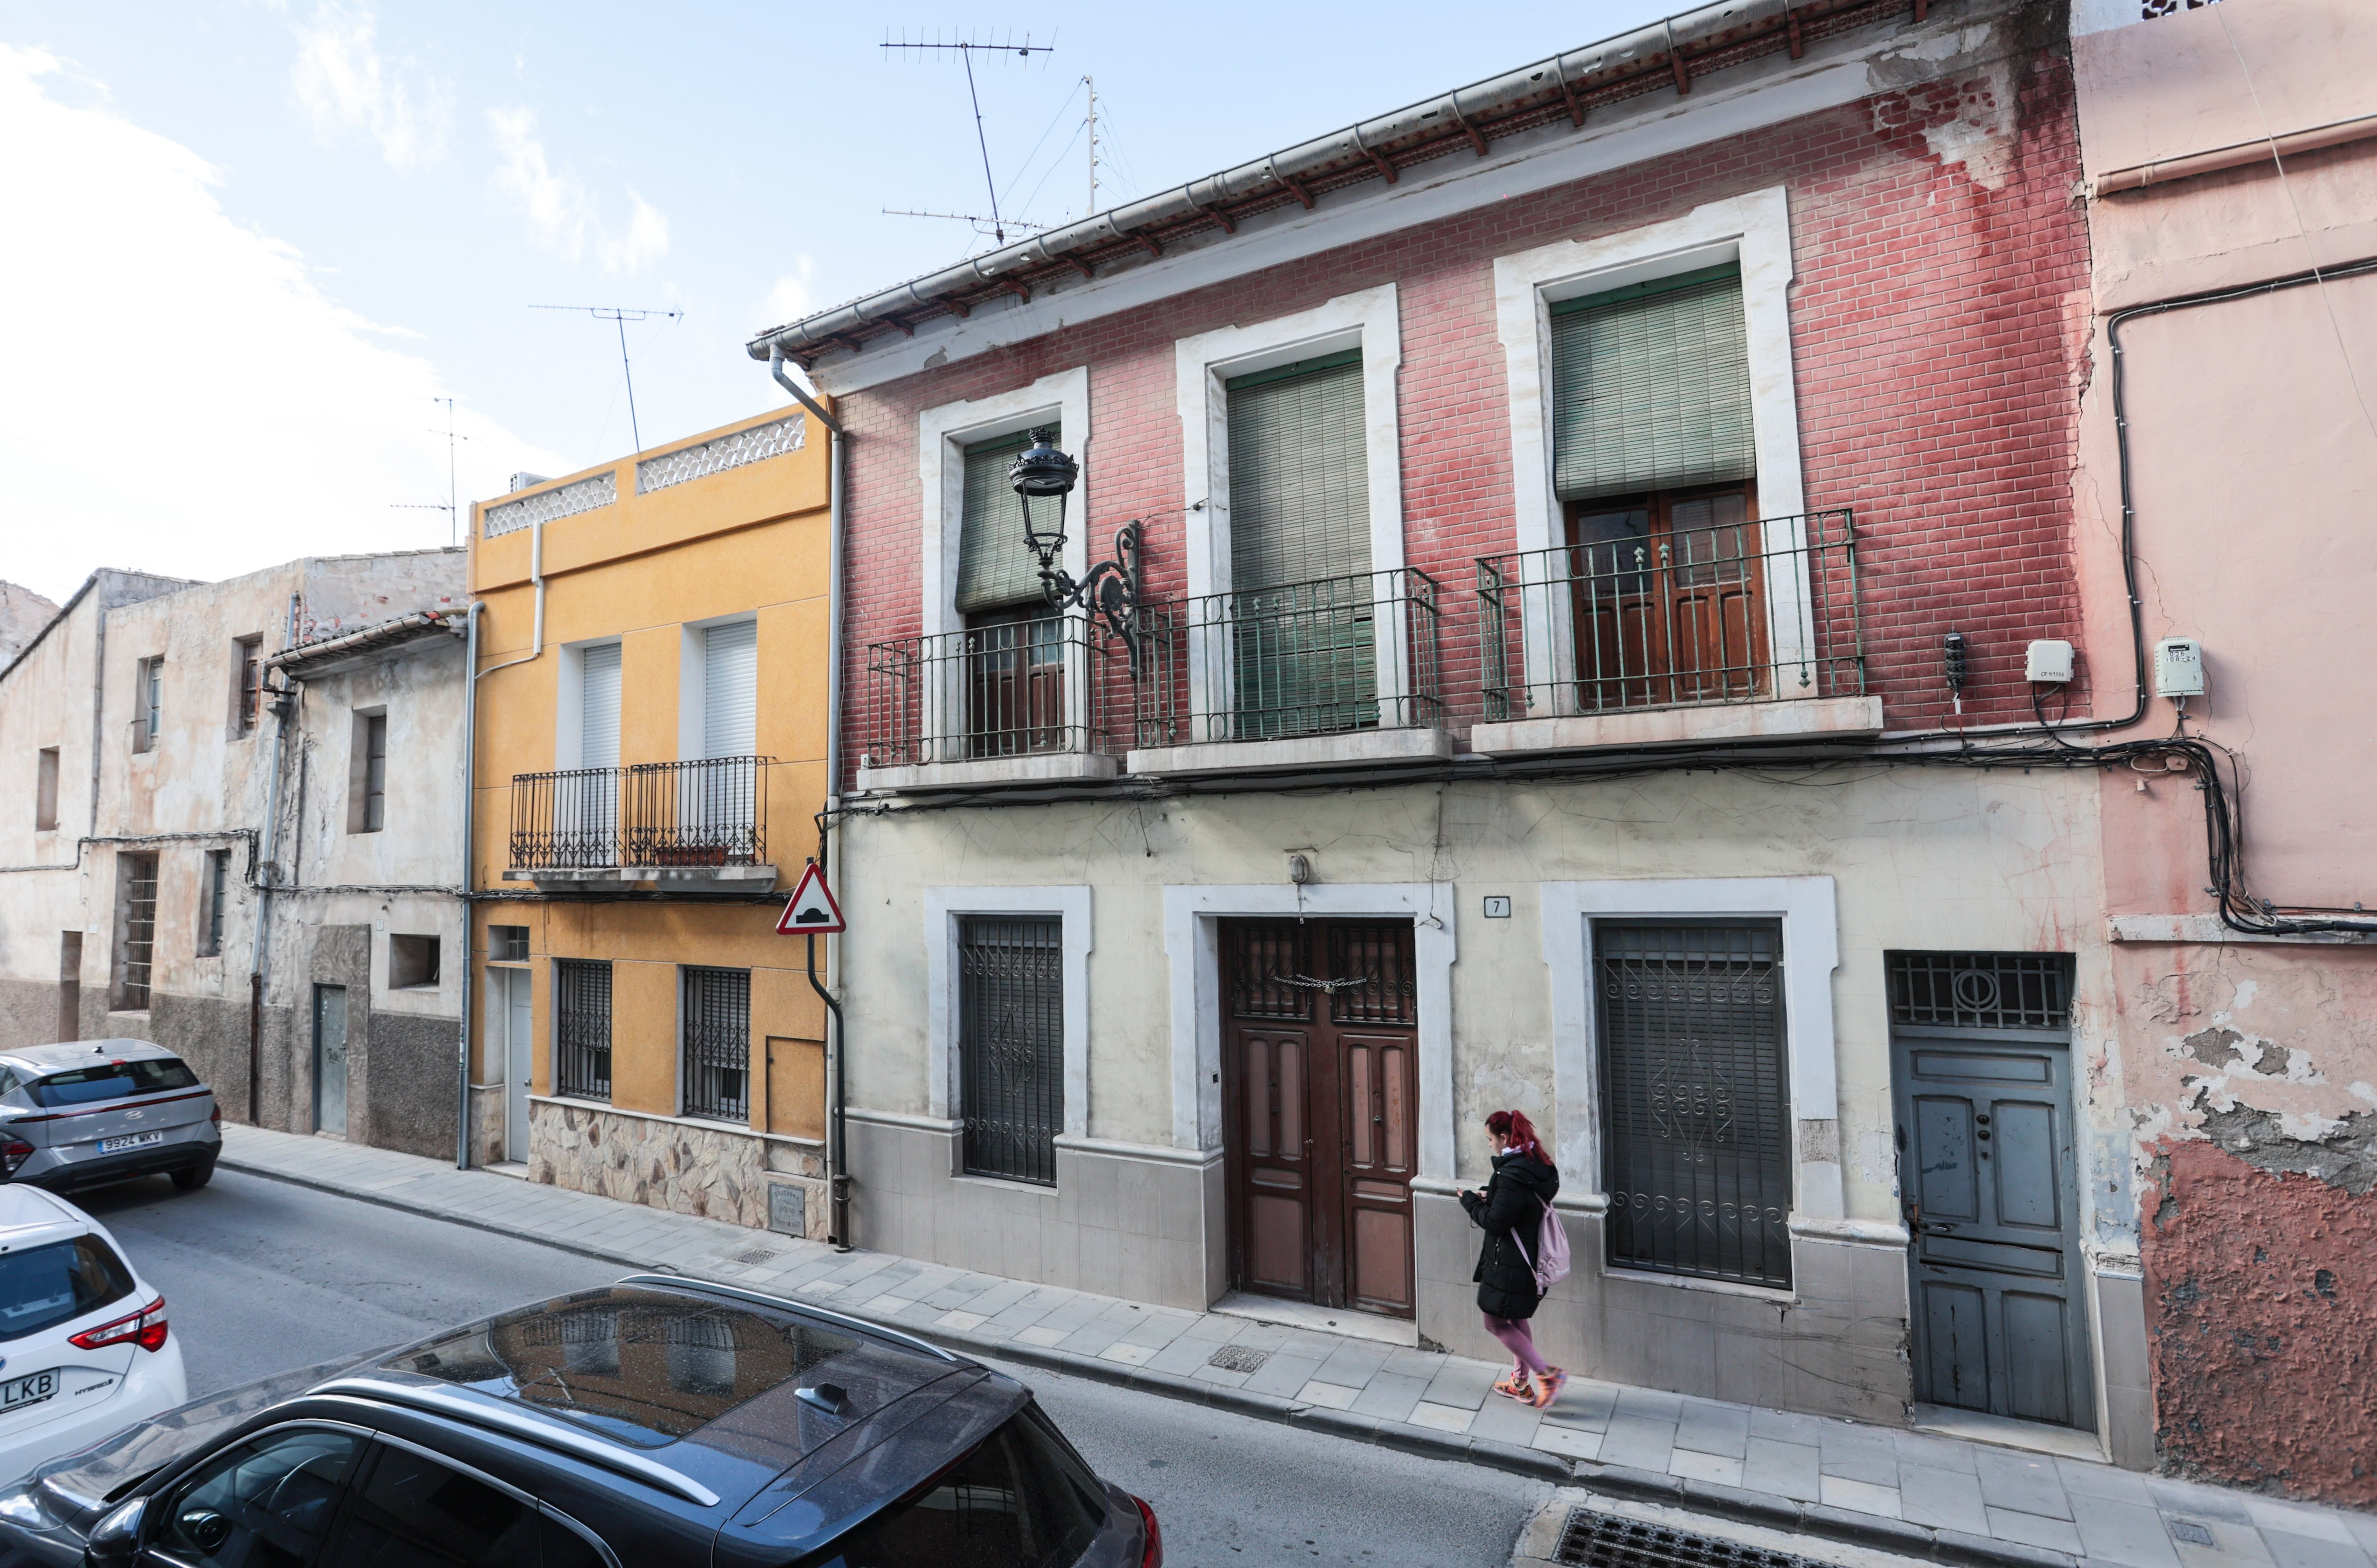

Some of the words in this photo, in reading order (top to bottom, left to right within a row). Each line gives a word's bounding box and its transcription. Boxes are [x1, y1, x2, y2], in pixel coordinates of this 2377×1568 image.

[1494, 901, 1500, 913] 7
[106, 1135, 135, 1149] 9924
[139, 1132, 160, 1143] MKV
[5, 1374, 52, 1404] LKB
